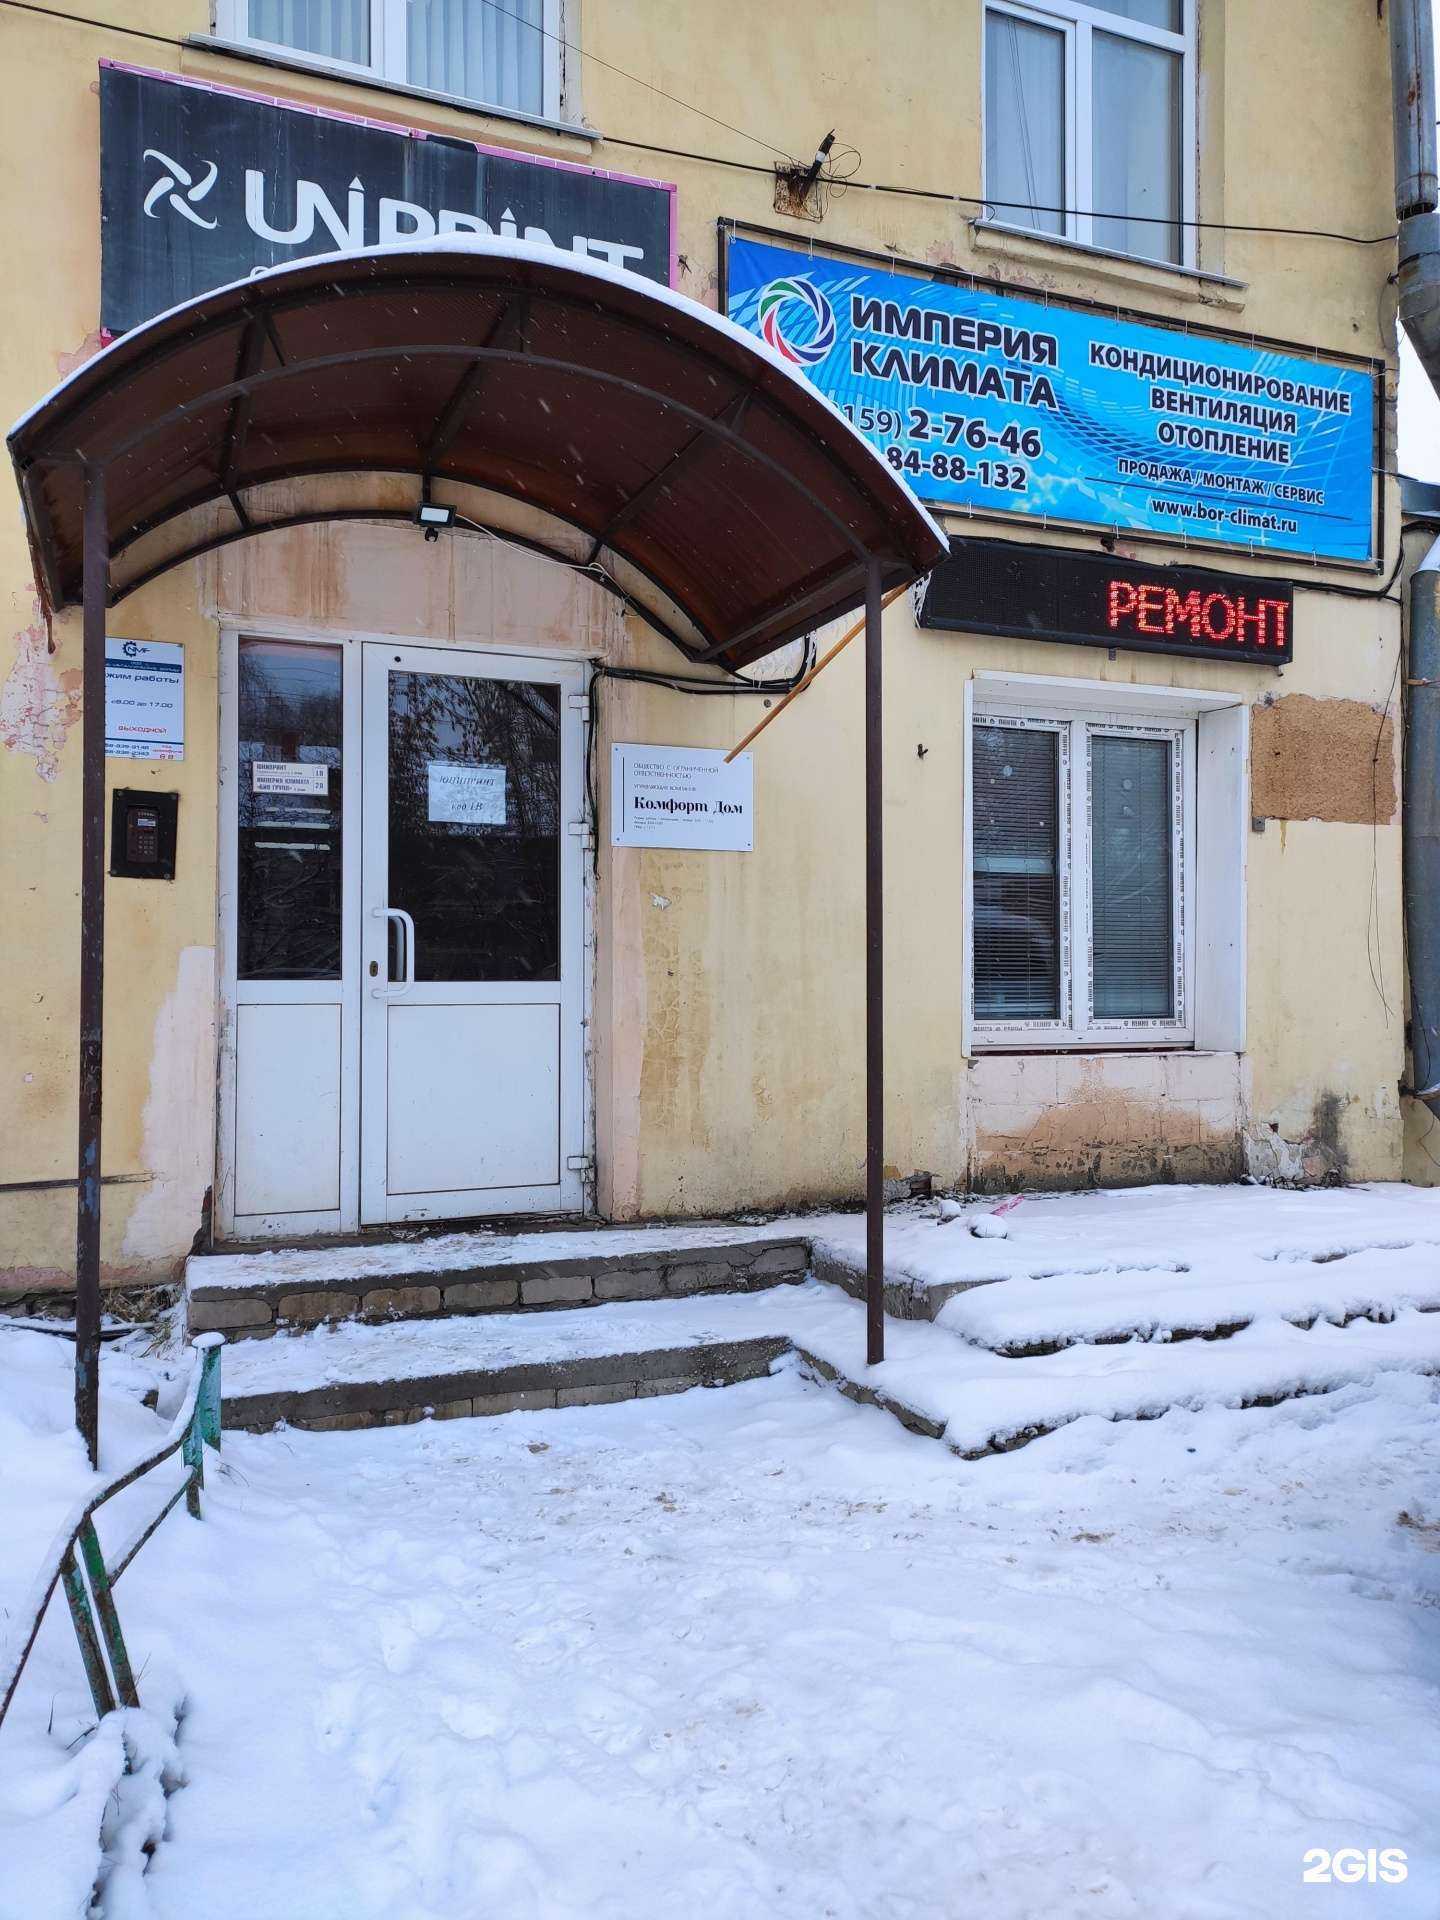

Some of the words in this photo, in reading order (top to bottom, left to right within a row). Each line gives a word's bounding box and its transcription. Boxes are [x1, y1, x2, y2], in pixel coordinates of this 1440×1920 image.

[852, 297, 1058, 366] ИМПЕРИЯ
[852, 341, 1058, 408] КЛИМАТА
[1089, 342, 1351, 414] КОНДИЦИОНИРОВАНИЕ
[832, 402, 902, 440] 159)
[908, 409, 1042, 458] 2-76-46
[1151, 388, 1297, 434] ВЕНТИЛЯЦИЯ
[1158, 422, 1290, 464] ОТОПЛЕНИЕ
[1117, 458, 1193, 485] ПРОДАЖА
[1203, 472, 1265, 496] МОНТАЖ
[1274, 485, 1325, 505] СЕРВИС
[1151, 499, 1298, 534] www.bor-climat.ru
[1109, 580, 1290, 647] РЕМОНТ
[634, 796, 709, 815] Комфорт
[712, 801, 744, 816] Дом
